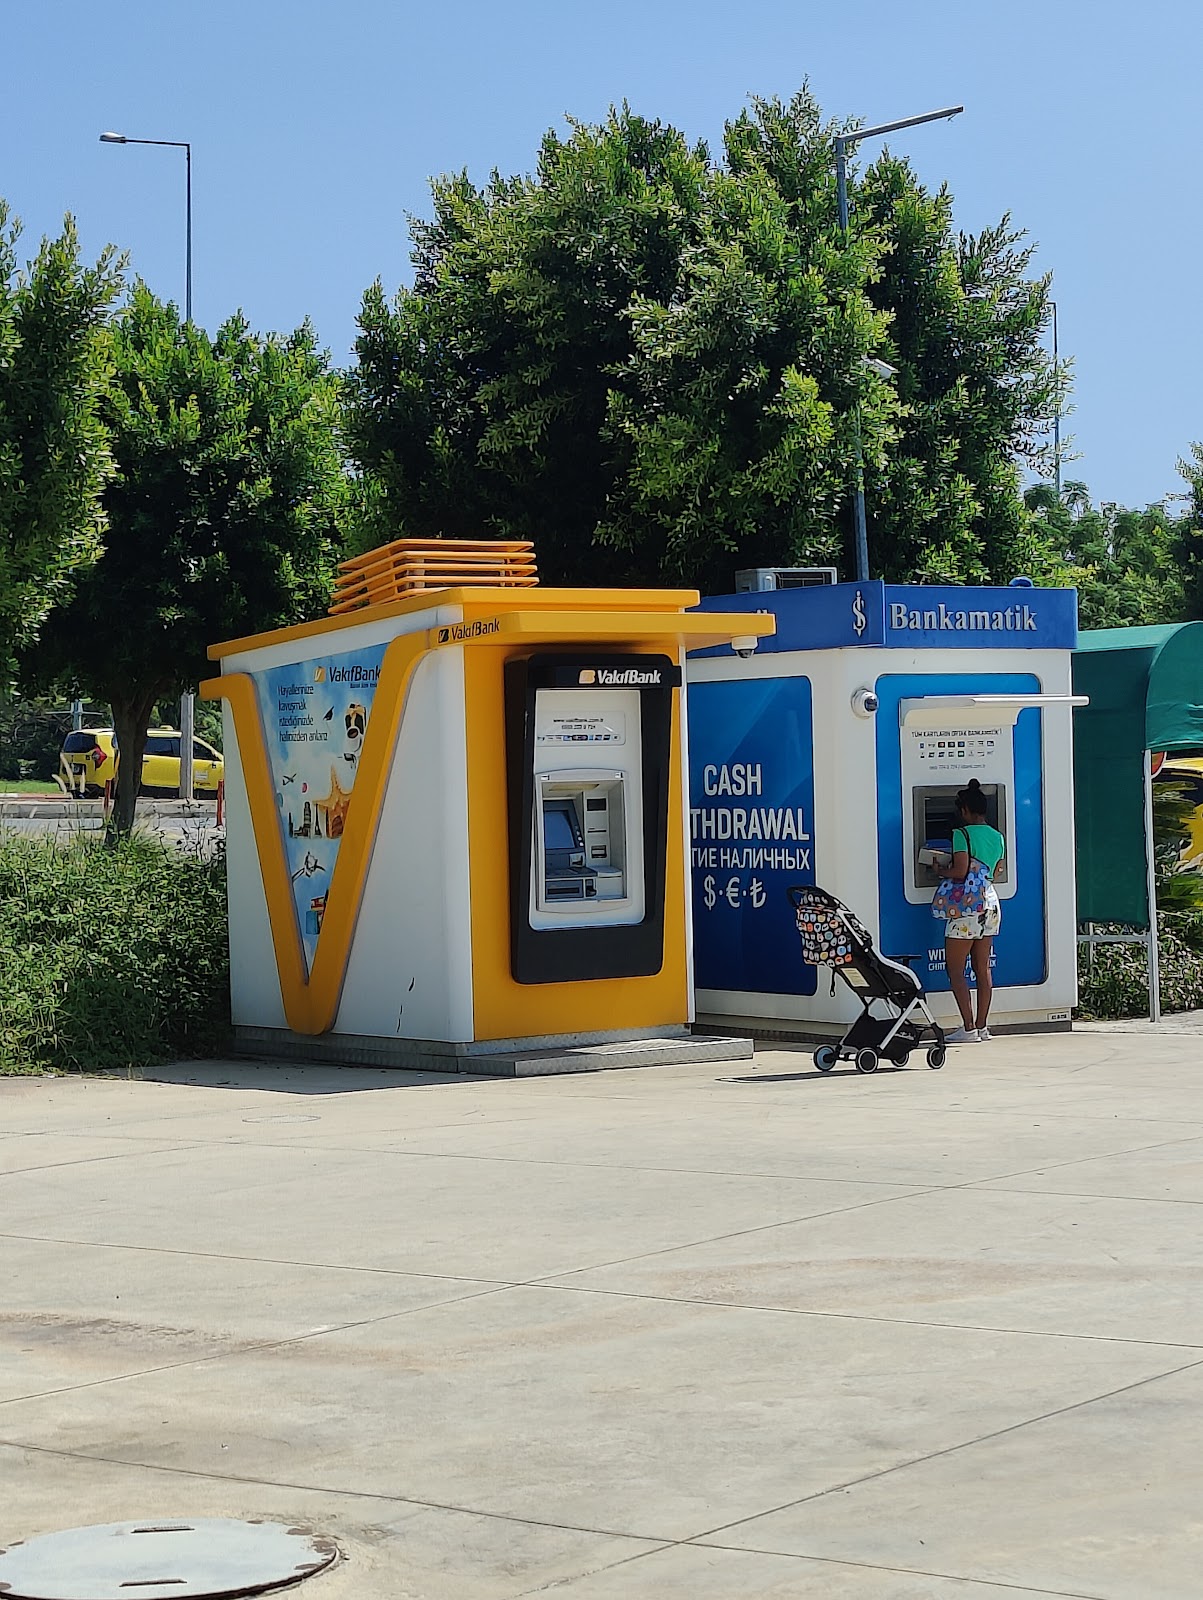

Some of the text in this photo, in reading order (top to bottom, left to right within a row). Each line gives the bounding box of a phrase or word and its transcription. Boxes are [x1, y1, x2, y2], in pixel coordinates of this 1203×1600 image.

[889, 602, 1038, 632] Bankamatik
[703, 763, 763, 796] CASH
[690, 807, 810, 840] THDRAWAL
[691, 847, 811, 870] ТИЕ НАЛИЧНЫХ
